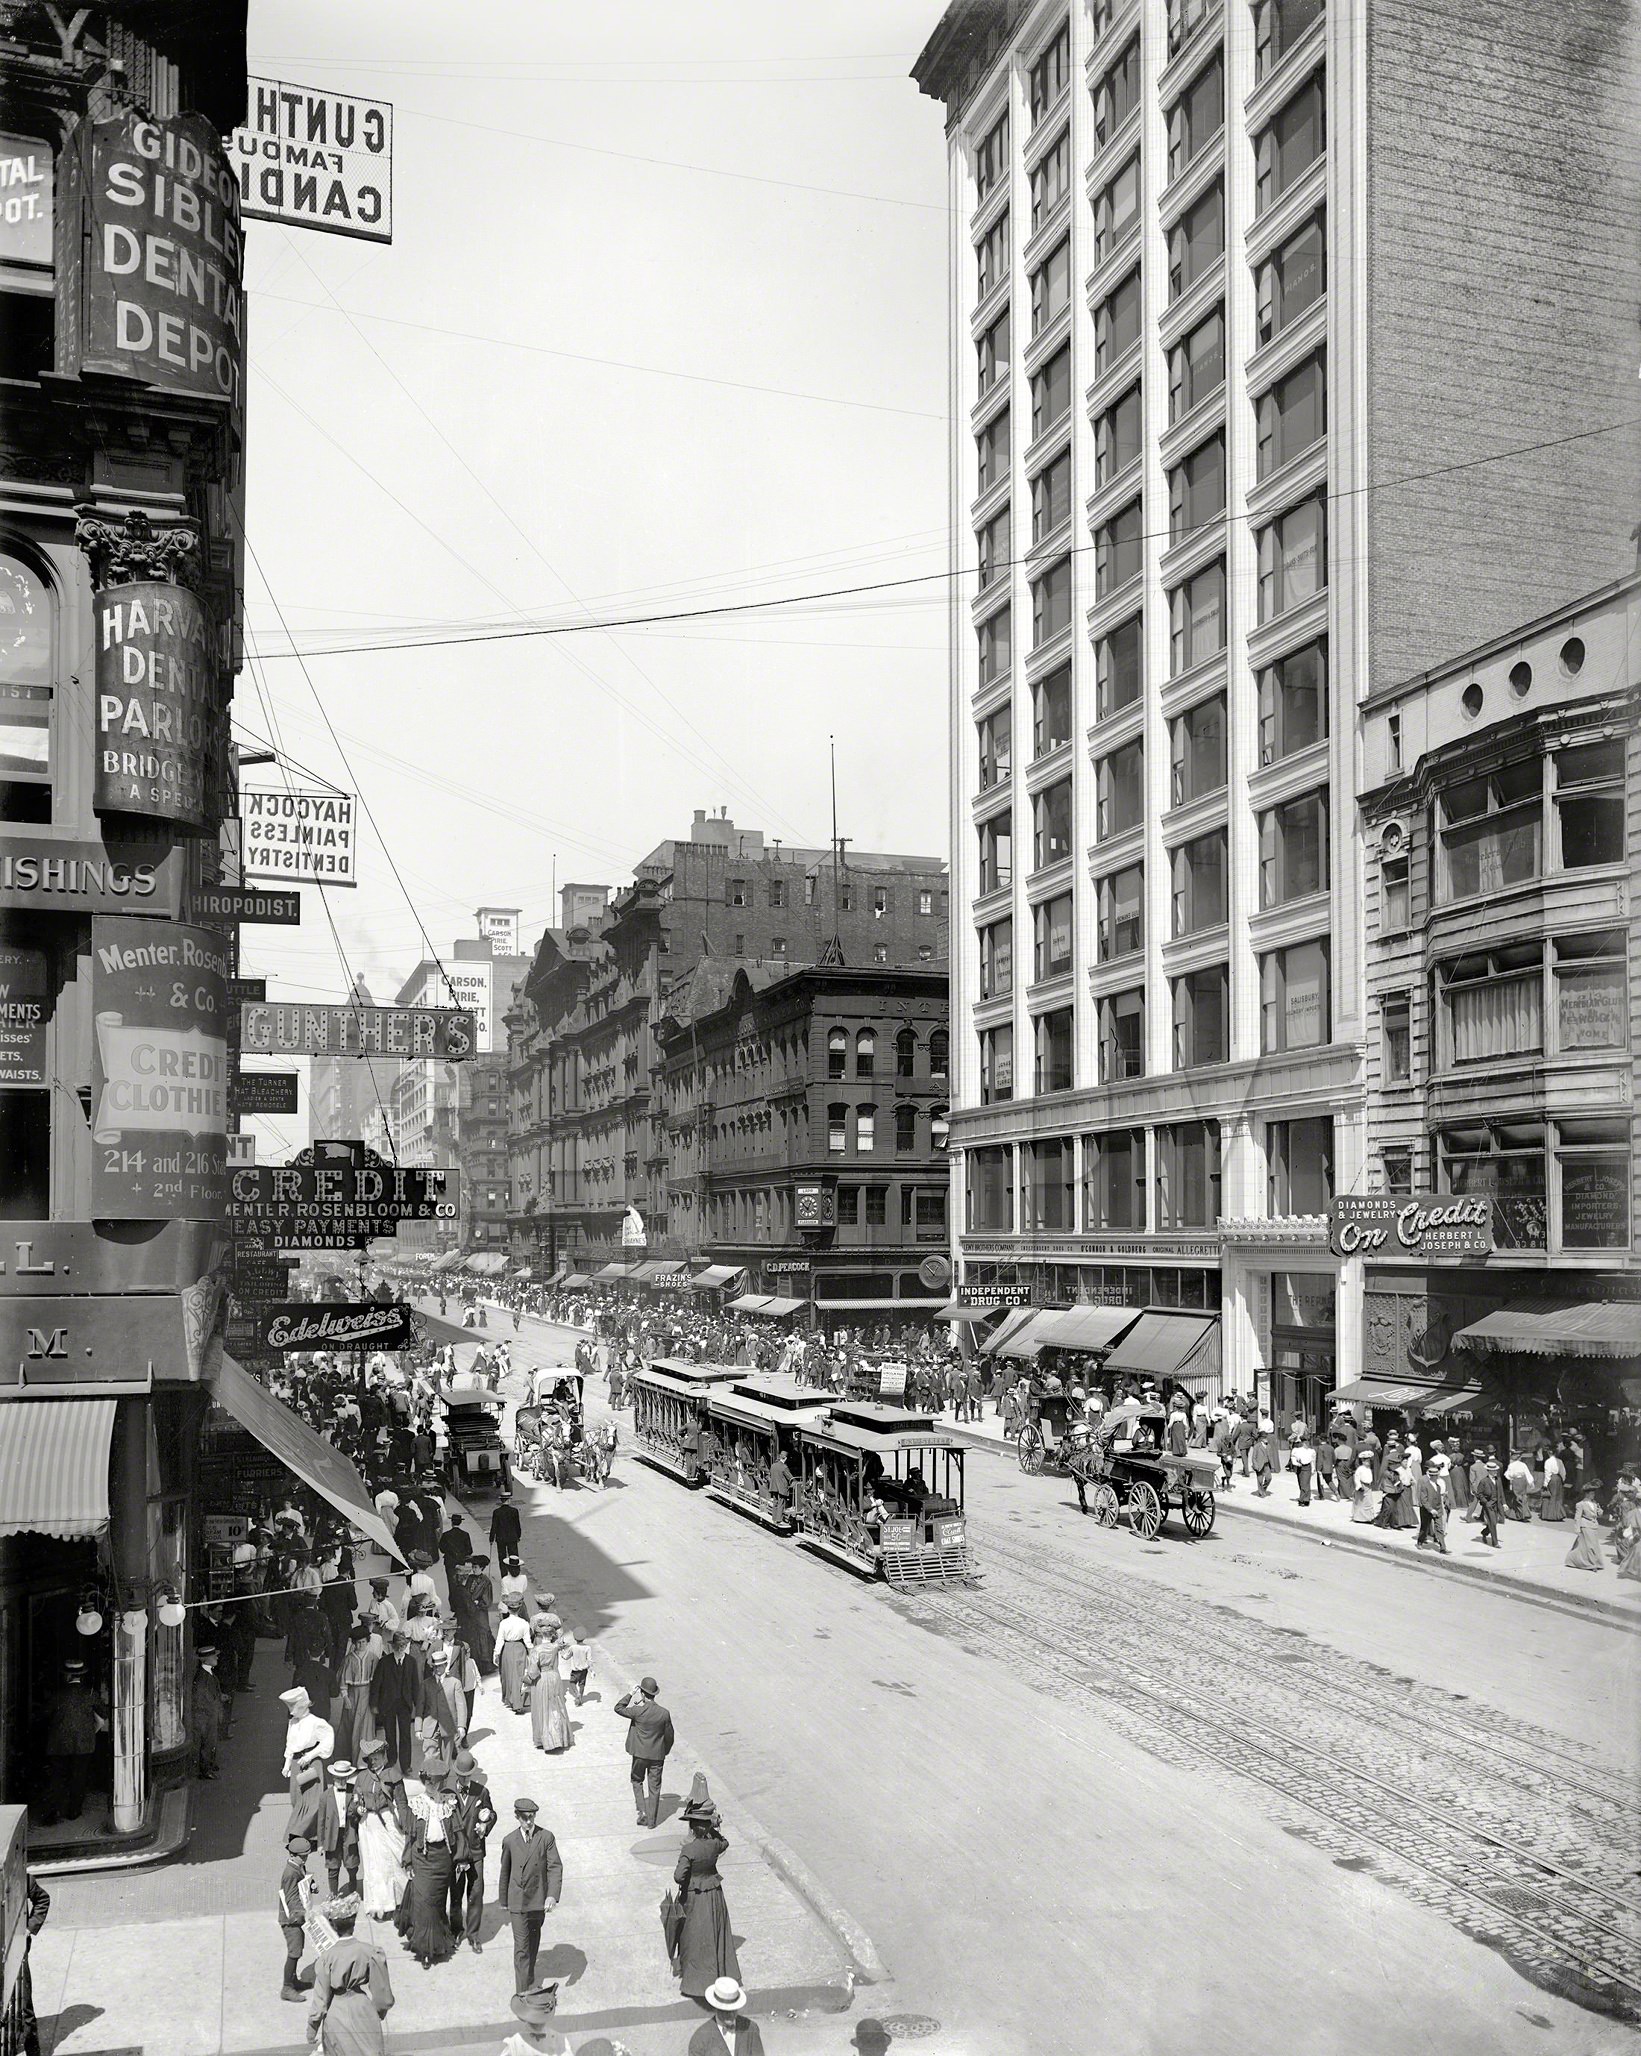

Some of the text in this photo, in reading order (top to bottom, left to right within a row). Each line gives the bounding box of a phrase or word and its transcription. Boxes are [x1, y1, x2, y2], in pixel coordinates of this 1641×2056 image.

[0, 193, 44, 224] OT.
[103, 750, 188, 786] BRIDGE
[130, 784, 141, 800] A
[192, 895, 298, 917] HIROPODIST.
[169, 983, 188, 1008] &
[226, 985, 261, 995] UTTLE
[247, 1007, 470, 1054] GUNTHER'S
[104, 1150, 147, 1174] 214
[153, 1153, 181, 1174] and
[185, 1150, 209, 1175] 216
[232, 1169, 446, 1202] CREDIT
[300, 1203, 413, 1217] ROSENBLOOM
[418, 1203, 431, 1217] &
[435, 1203, 456, 1218] CO
[1338, 1200, 1397, 1209] DIAMONDS
[1338, 1210, 1396, 1220] & JEWELRY
[1396, 1198, 1488, 1246] Credit
[234, 1219, 395, 1235] EASY PAYMENTS
[275, 1235, 355, 1247] DIAMONDS
[1339, 1222, 1389, 1252] On
[1425, 1231, 1485, 1240] HERBERT L.
[1421, 1241, 1488, 1250] JOSEPH & CO.
[655, 1273, 692, 1282] FRAZIN'S
[960, 1286, 1030, 1295] INDEPENDENT
[970, 1296, 1020, 1306] DRUG CO
[267, 1307, 403, 1348] Edelweiss
[321, 1342, 335, 1350] ON
